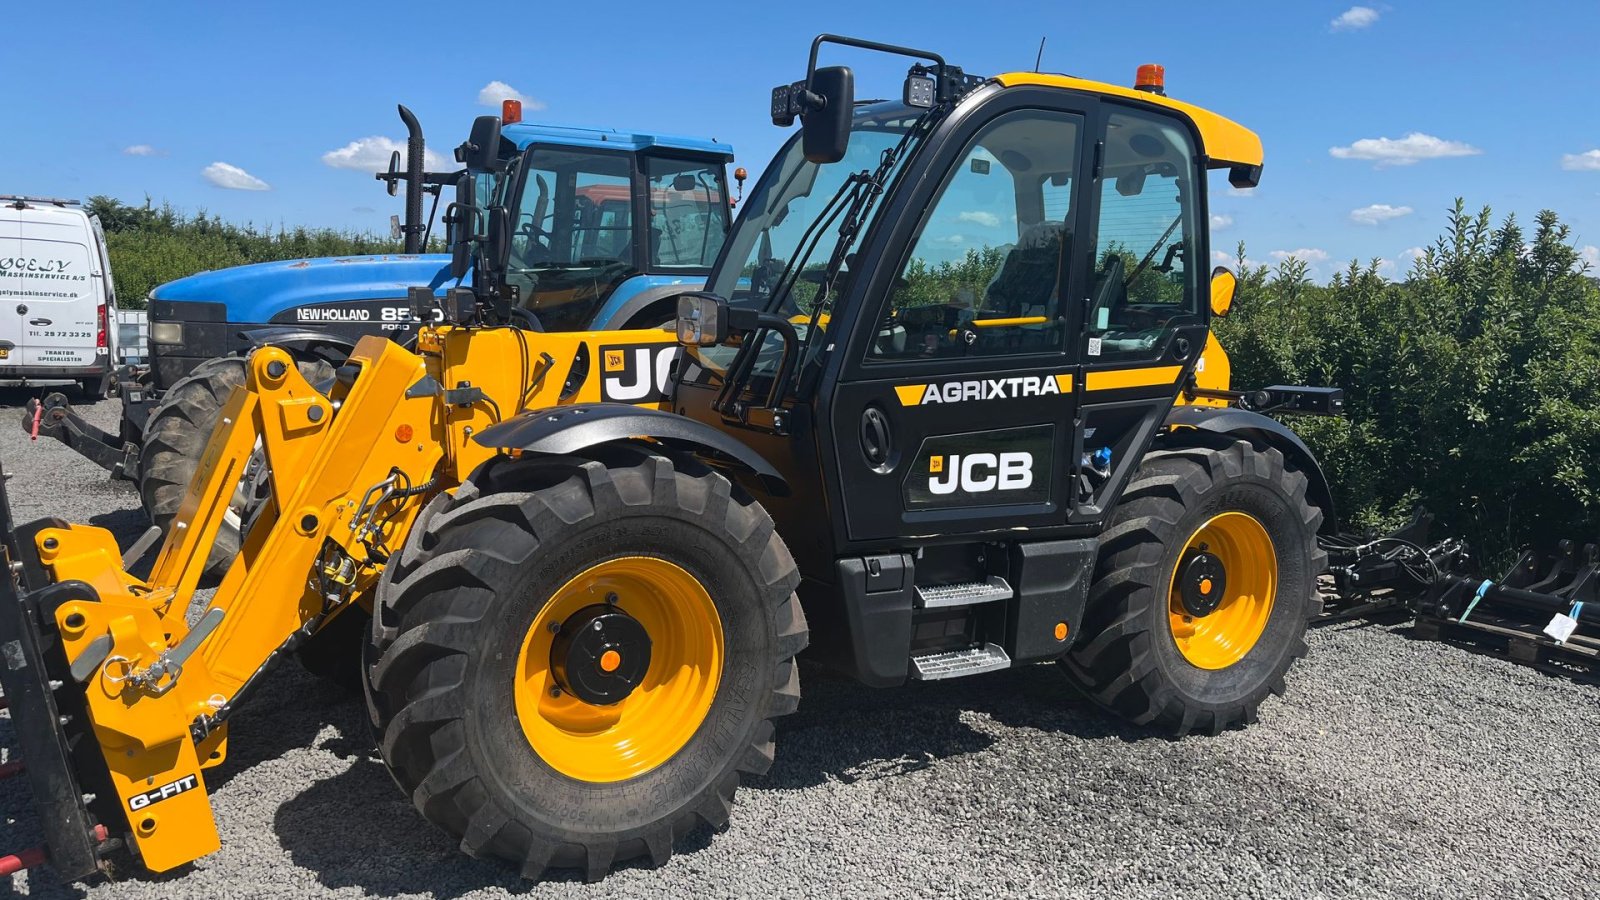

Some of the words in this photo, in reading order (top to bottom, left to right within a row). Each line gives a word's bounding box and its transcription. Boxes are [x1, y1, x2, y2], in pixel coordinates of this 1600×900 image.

[297, 308, 321, 320] NEW
[321, 309, 370, 321] HOLLAND
[381, 307, 444, 322] 850
[381, 323, 410, 331] FORD
[921, 375, 1060, 405] AGRIXTRA
[928, 451, 1033, 495] JCB
[129, 774, 195, 810] Q-FIT
